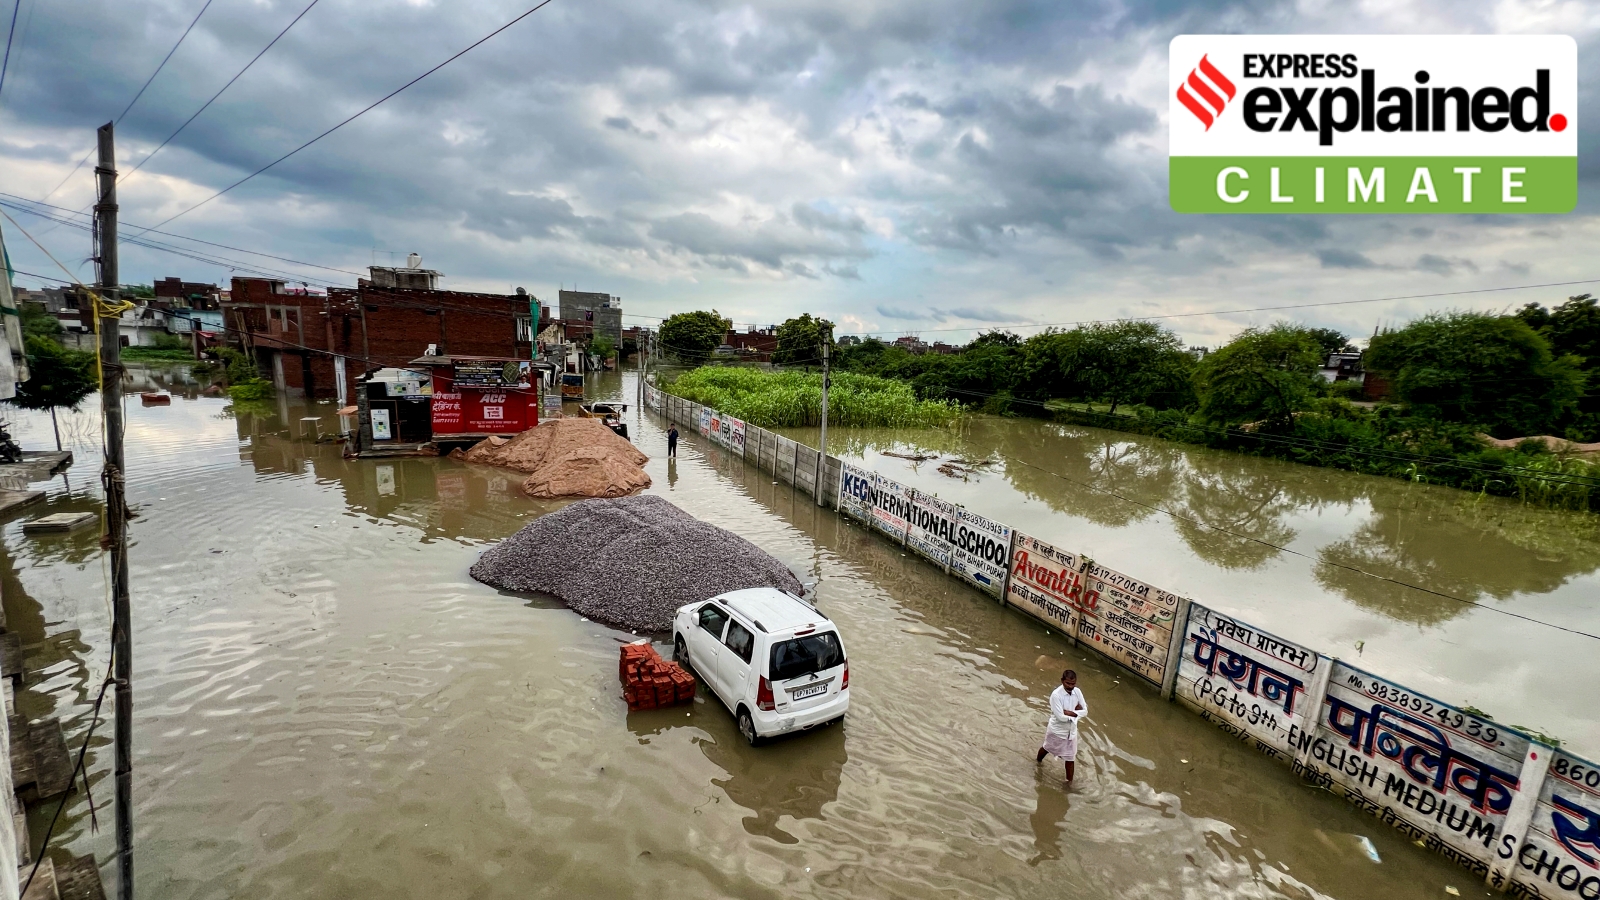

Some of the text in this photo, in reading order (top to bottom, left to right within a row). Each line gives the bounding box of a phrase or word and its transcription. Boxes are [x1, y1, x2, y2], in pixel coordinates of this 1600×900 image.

[479, 393, 507, 404] ACC
[843, 472, 868, 502] KEC
[868, 485, 957, 546] INTERNATIONAL
[957, 525, 1009, 569] SCHOOL
[1012, 550, 1100, 610] Avantika
[1046, 600, 1071, 625] सरसों
[1079, 615, 1096, 639] तेल
[1190, 626, 1305, 717] पैशन
[1287, 723, 1379, 788] ENGLISH
[1383, 772, 1496, 849] MEDIUM
[1325, 694, 1521, 815] पब्लिक
